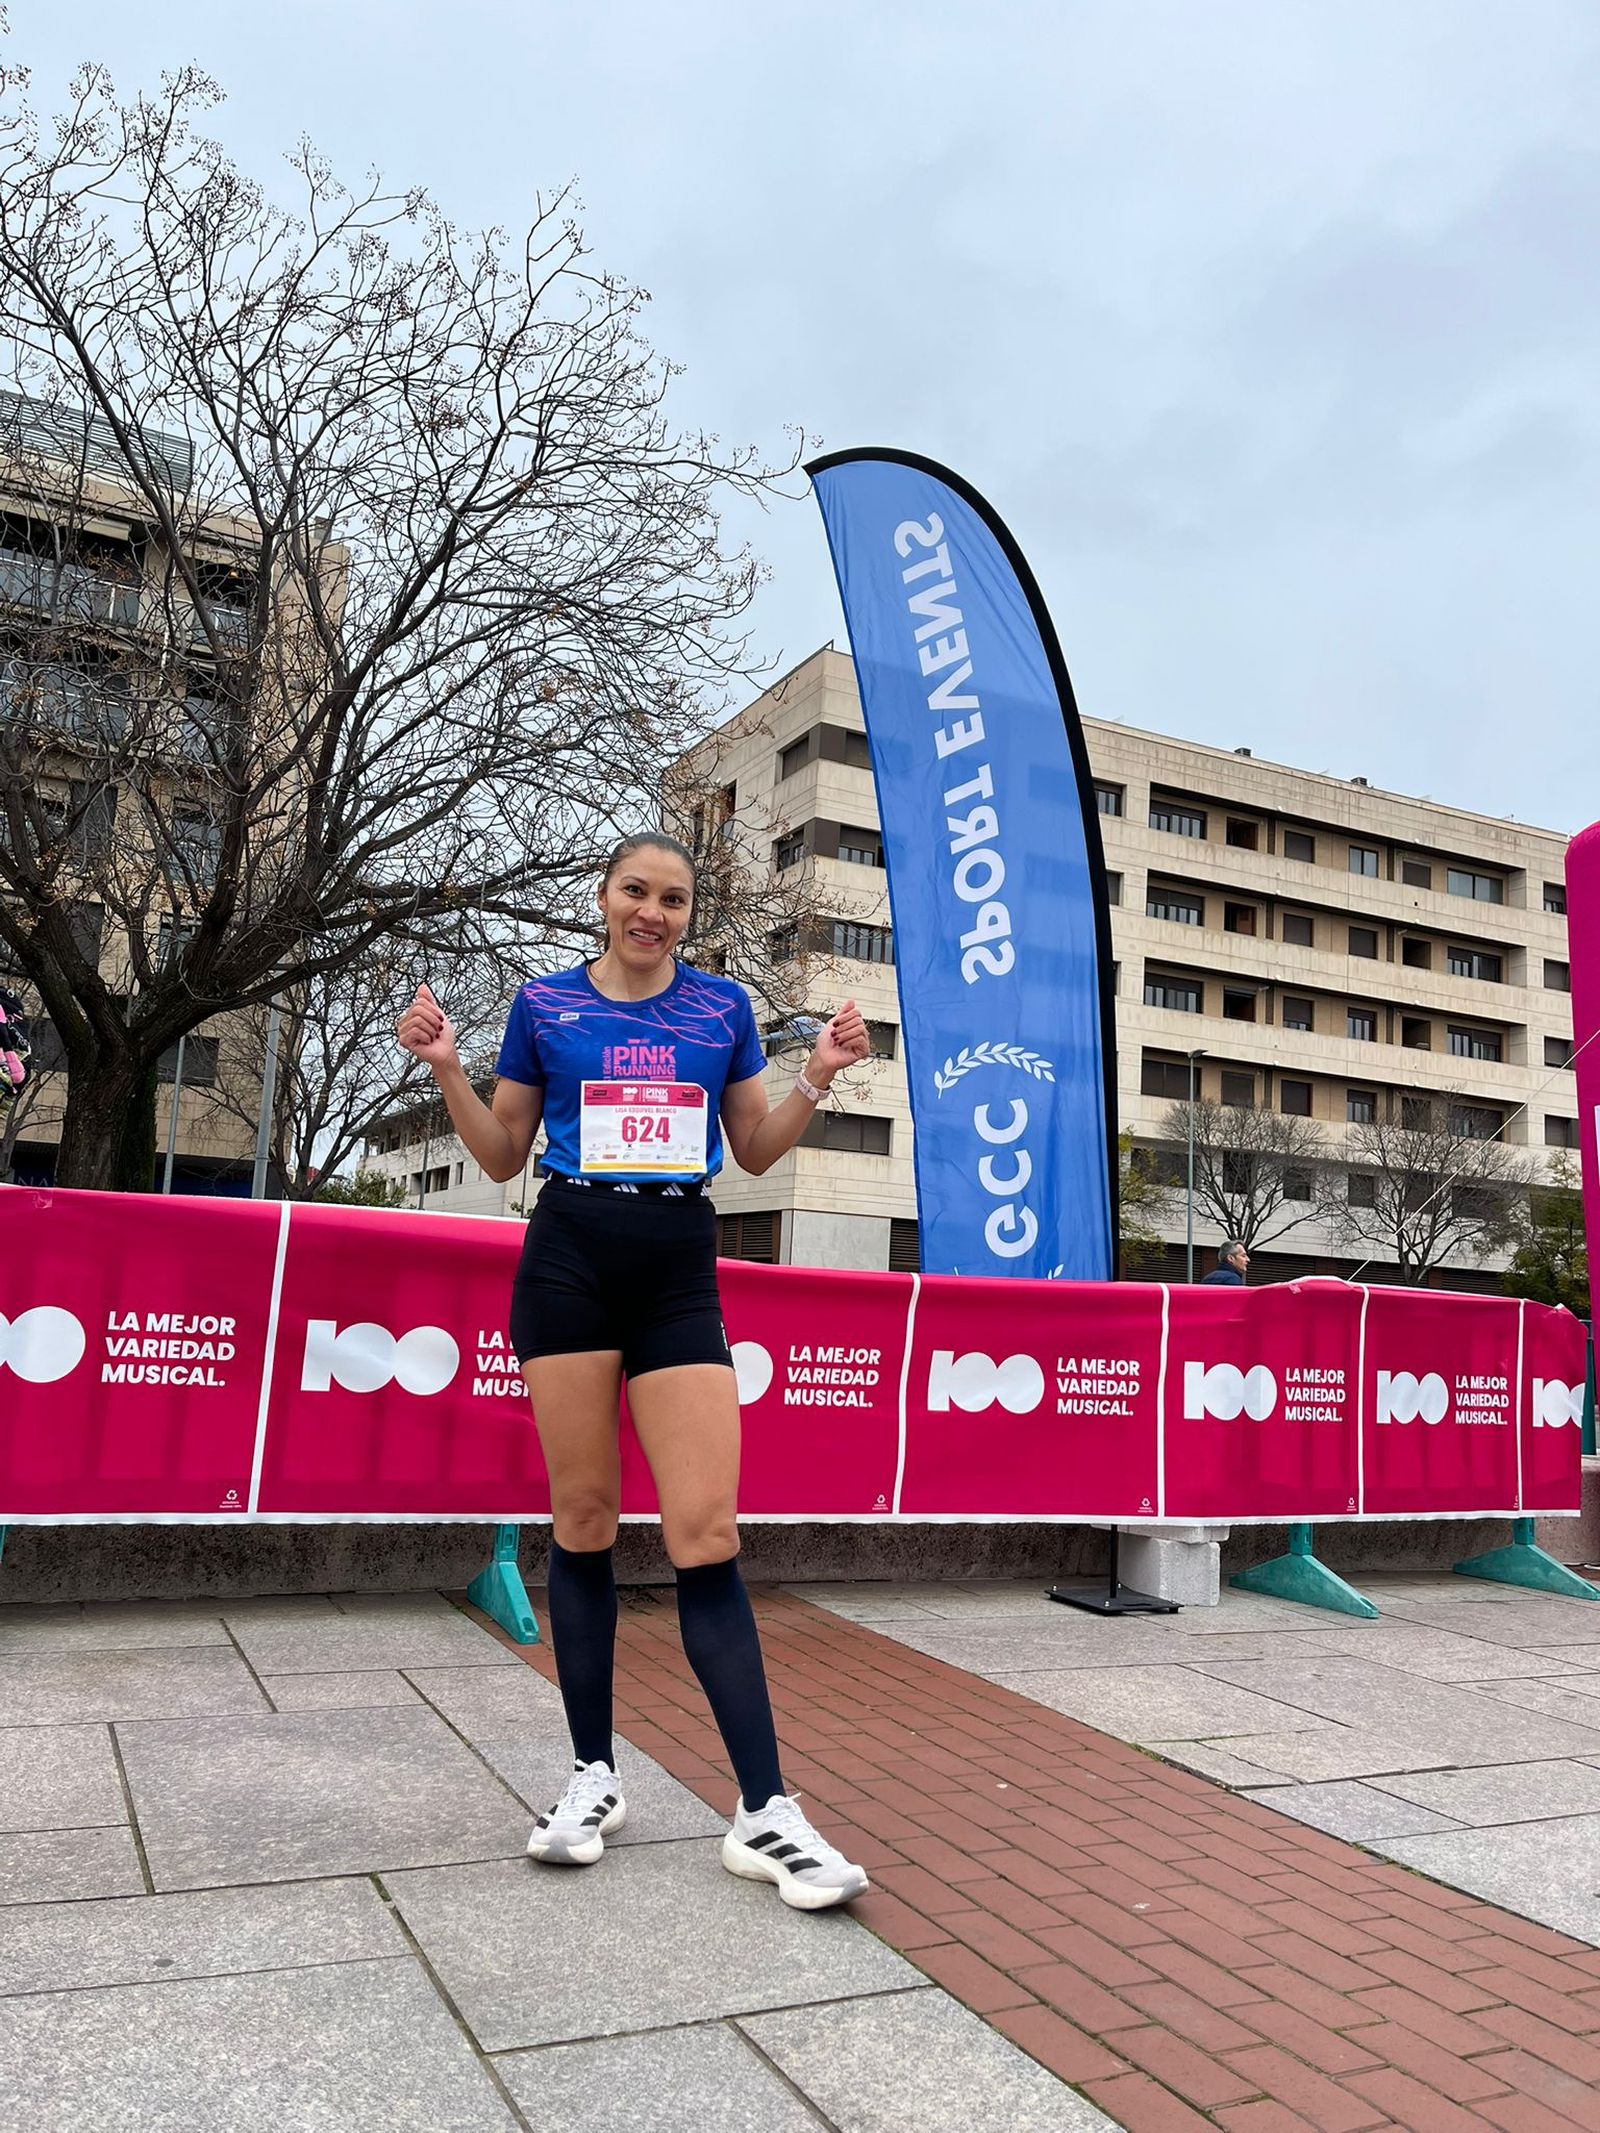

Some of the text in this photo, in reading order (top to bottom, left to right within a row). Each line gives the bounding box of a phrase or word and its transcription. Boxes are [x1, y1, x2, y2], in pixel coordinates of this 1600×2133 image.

[613, 1045, 676, 1065] PINK
[613, 1064, 676, 1077] RUNNING
[622, 1116, 670, 1143] 624
[107, 1311, 236, 1336] LA MEJOR
[105, 1336, 236, 1361] VARIEDAD
[477, 1330, 505, 1349] LA
[789, 1345, 881, 1365] LA MEJOR
[101, 1363, 226, 1387] MUSICAL.
[787, 1366, 880, 1386] VARIEDAD
[1057, 1357, 1140, 1376] LA MEJOR
[1285, 1367, 1345, 1385] LA MEJOR
[927, 1349, 1045, 1414] 100
[1056, 1377, 1140, 1396] VARIEDAD
[1455, 1375, 1508, 1391] LA MEJOR
[784, 1388, 873, 1408] MUSICAL.
[1183, 1361, 1278, 1422] 100
[1285, 1386, 1346, 1403] VARIEDAD
[1376, 1370, 1449, 1425] 100
[1455, 1392, 1510, 1408] VARIEDAD
[1057, 1398, 1134, 1416] MUSICAL.
[1285, 1405, 1343, 1422] MUSICAL.
[1455, 1410, 1508, 1425] MUSICAL.
